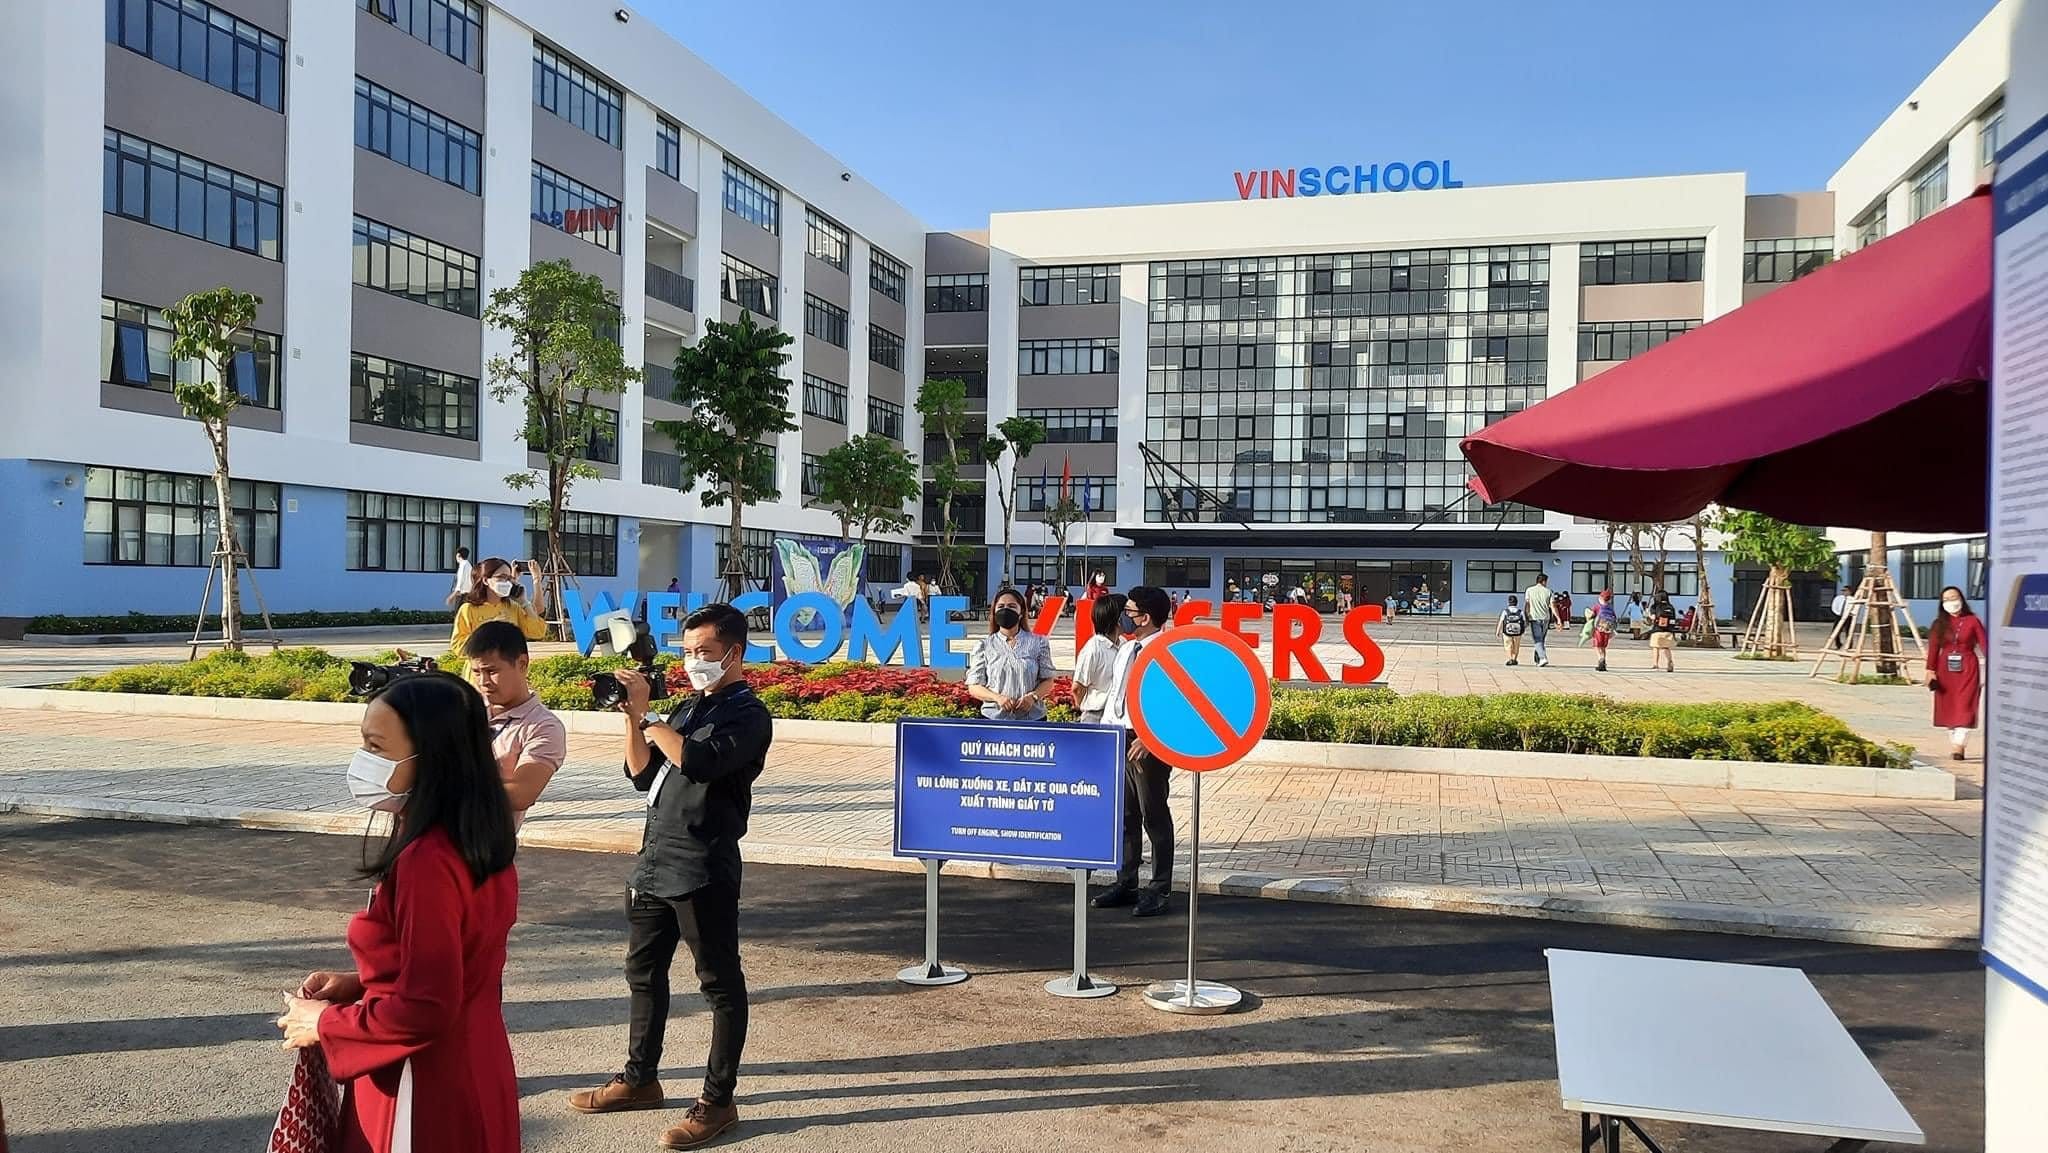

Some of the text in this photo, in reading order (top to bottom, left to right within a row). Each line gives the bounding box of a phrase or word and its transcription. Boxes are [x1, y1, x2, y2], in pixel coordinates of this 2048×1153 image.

[1234, 160, 1463, 200] VINSCHOOL
[565, 589, 971, 668] WECOME
[961, 739, 982, 756] QUÝ
[985, 741, 1021, 757] KHÁCH
[1023, 743, 1045, 758] CHÚ
[917, 776, 933, 789] VUI
[1034, 781, 1047, 793] XE
[1049, 782, 1068, 795] QUA
[951, 827, 966, 836] TURN
[1001, 830, 1018, 839] SHOW
[1018, 831, 1062, 841] IDENTIFICATION
